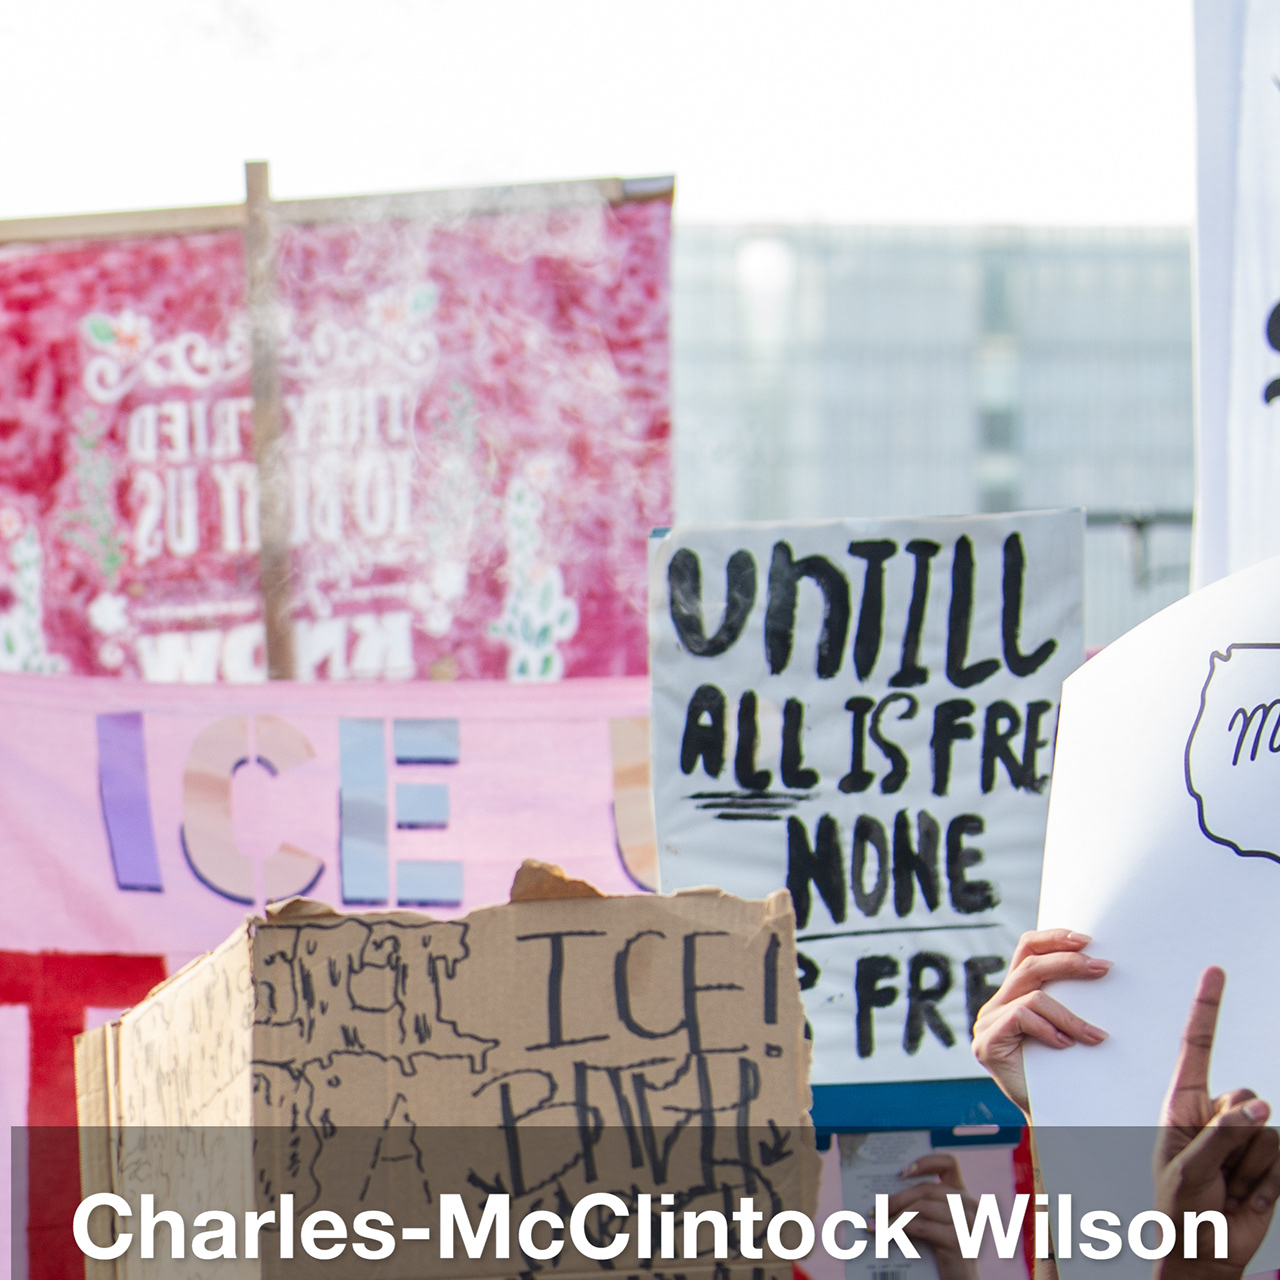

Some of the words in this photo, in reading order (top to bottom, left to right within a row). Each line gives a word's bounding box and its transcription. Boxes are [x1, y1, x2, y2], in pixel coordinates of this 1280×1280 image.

[680, 683, 821, 791] ALL
[838, 691, 920, 794] IS
[929, 698, 1062, 796] FRE
[94, 710, 465, 908] ICE
[786, 807, 1001, 931] NONE
[854, 950, 1011, 1059] FRE
